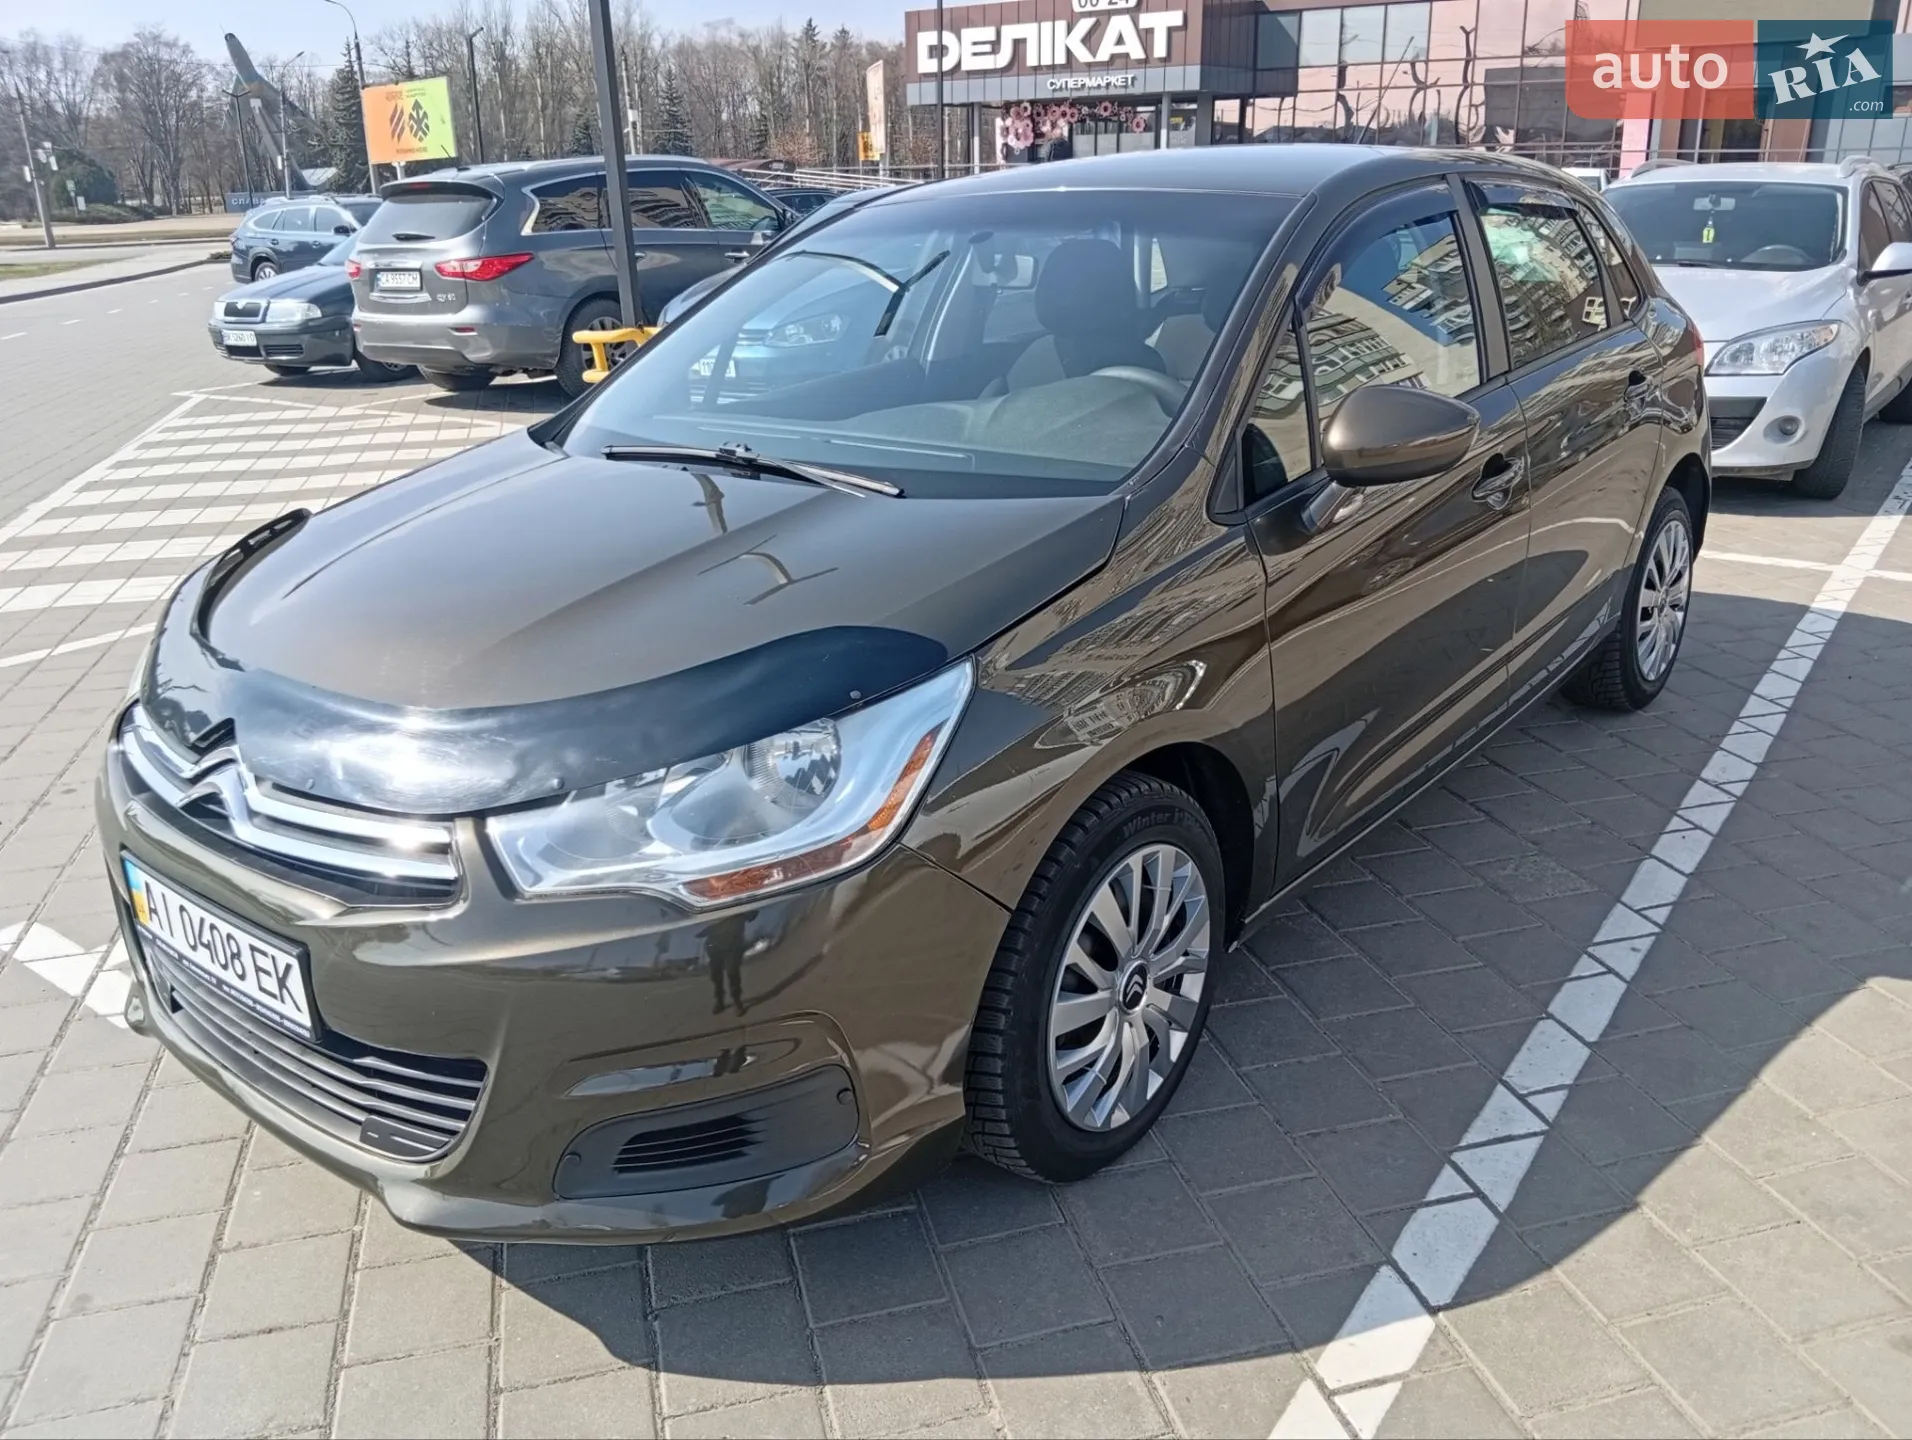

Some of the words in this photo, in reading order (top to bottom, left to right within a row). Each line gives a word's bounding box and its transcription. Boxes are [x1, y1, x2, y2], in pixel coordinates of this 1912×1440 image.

[1046, 74, 1134, 91] СУПЕРМАРКЕТ
[1123, 811, 1171, 838] Winter
[144, 880, 174, 938] AI
[179, 904, 247, 982] 0408
[248, 943, 304, 1014] EK
